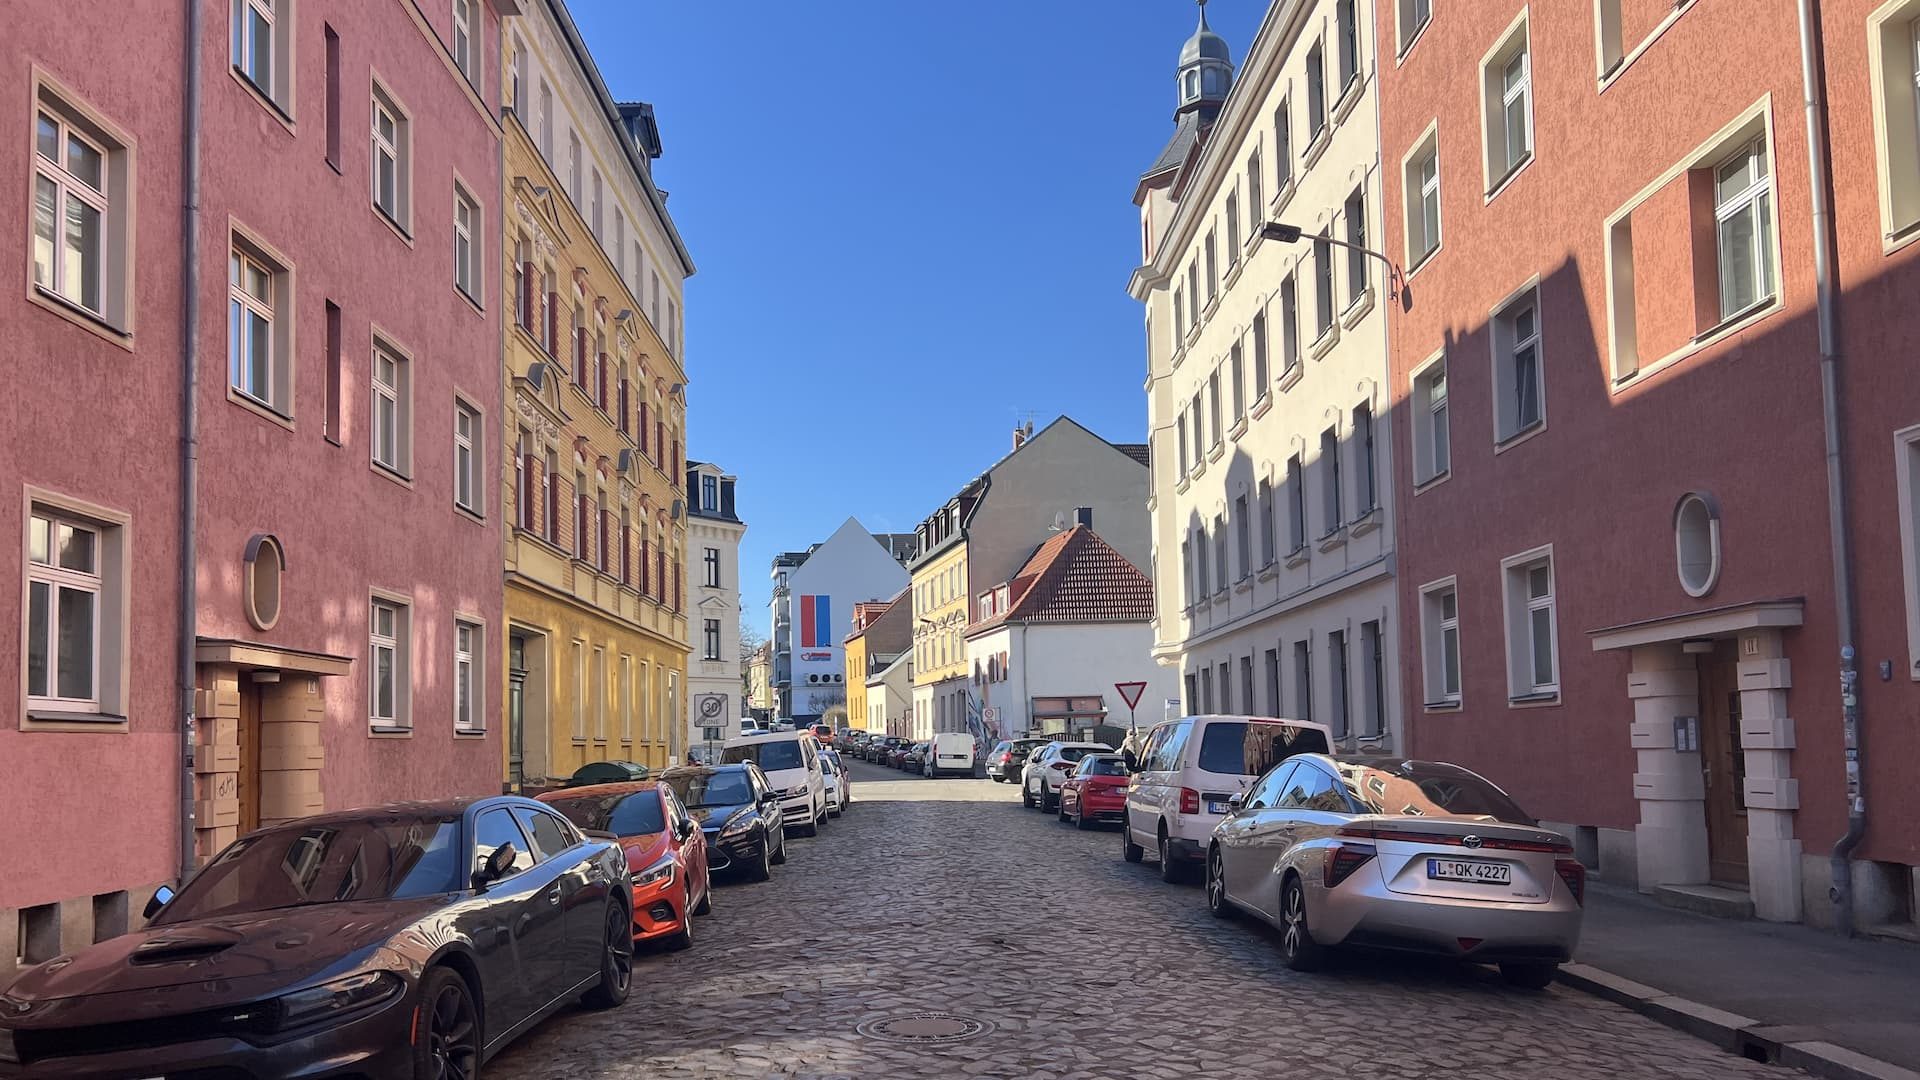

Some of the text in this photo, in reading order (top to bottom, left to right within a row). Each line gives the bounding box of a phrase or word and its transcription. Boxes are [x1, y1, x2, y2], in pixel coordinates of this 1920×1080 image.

[704, 702, 718, 713] 30
[1455, 863, 1473, 877] QK
[1475, 865, 1508, 880] 4227
